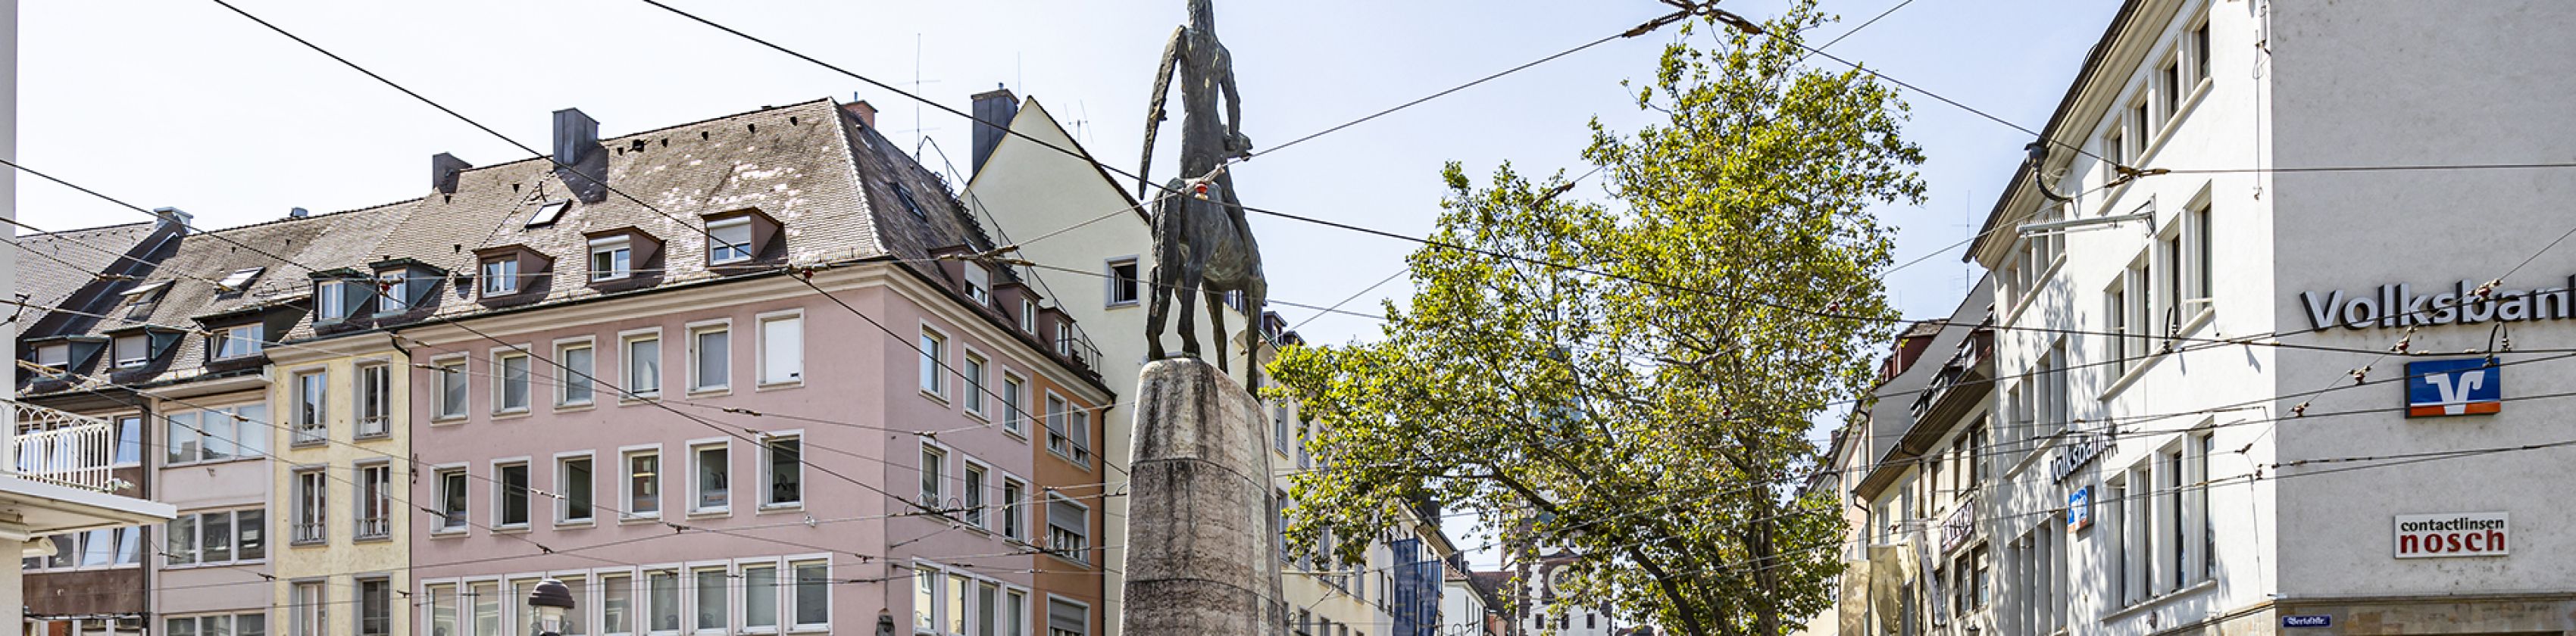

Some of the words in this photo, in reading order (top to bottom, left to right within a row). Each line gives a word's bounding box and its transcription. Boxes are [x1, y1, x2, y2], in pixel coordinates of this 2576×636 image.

[2300, 275, 2575, 330] Volksban
[2400, 517, 2504, 532] contactlinsen
[2400, 529, 2505, 553] nosch
